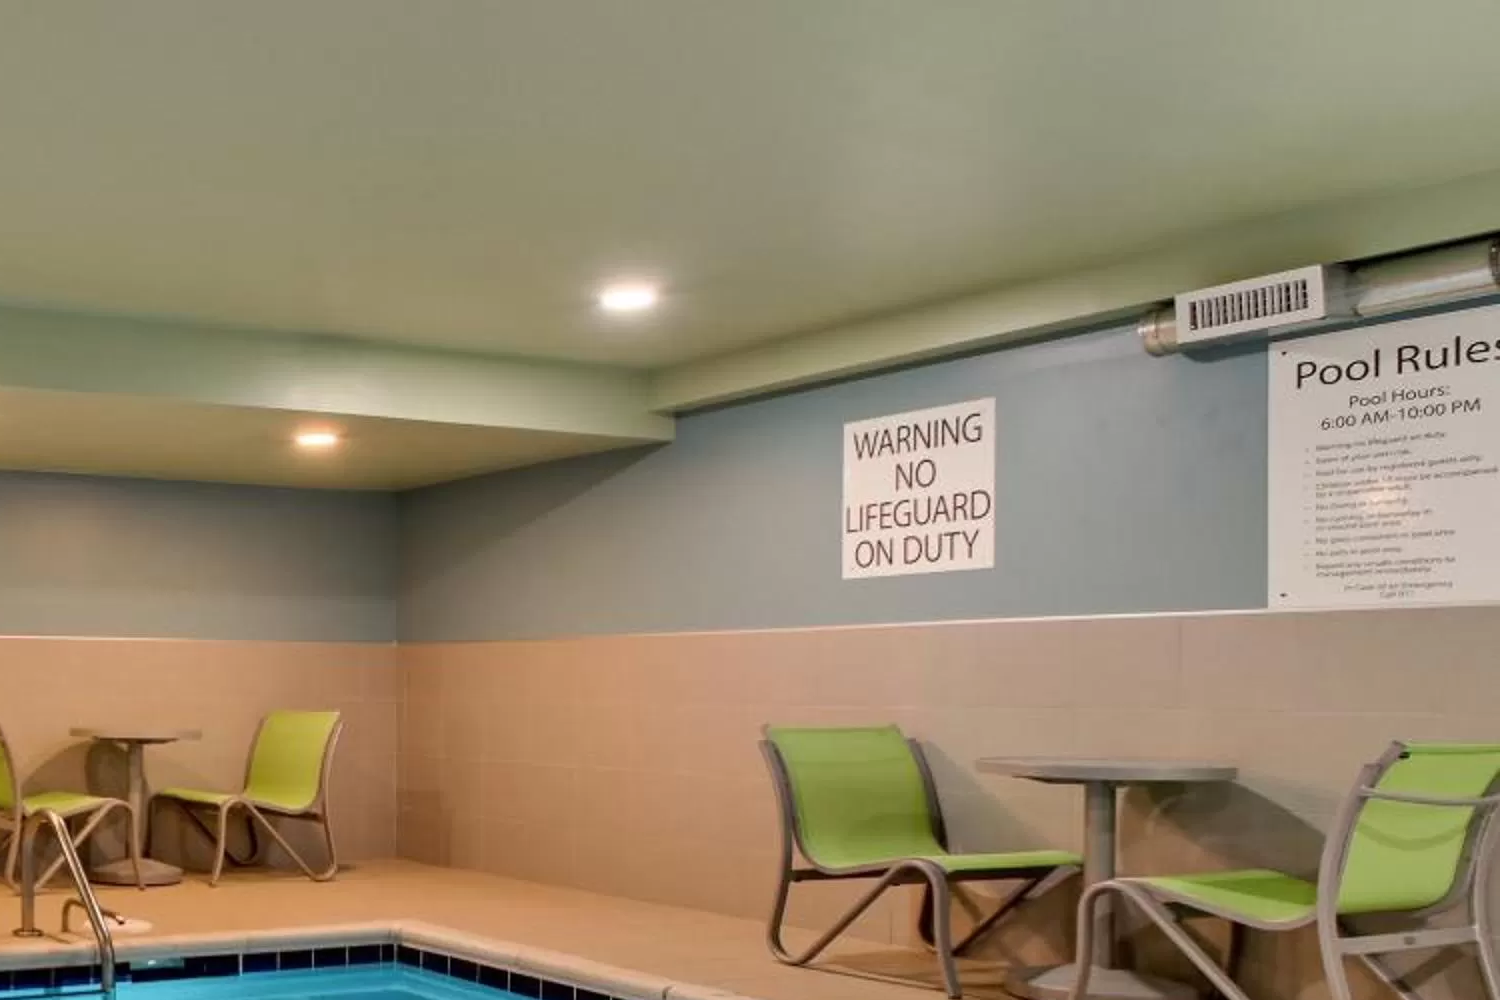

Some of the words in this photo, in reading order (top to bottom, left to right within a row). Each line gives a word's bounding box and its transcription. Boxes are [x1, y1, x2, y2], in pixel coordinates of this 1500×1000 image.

[1297, 349, 1380, 389] Pool
[1320, 415, 1357, 431] 6:00
[1451, 398, 1482, 414] PM
[1349, 391, 1387, 408] Pool
[1391, 384, 1450, 403] Hours:
[853, 413, 983, 461] WARNING
[895, 459, 937, 491] NO
[846, 489, 992, 533] LIFEGUARD
[855, 537, 894, 568] ON
[903, 529, 980, 565] DUTY
